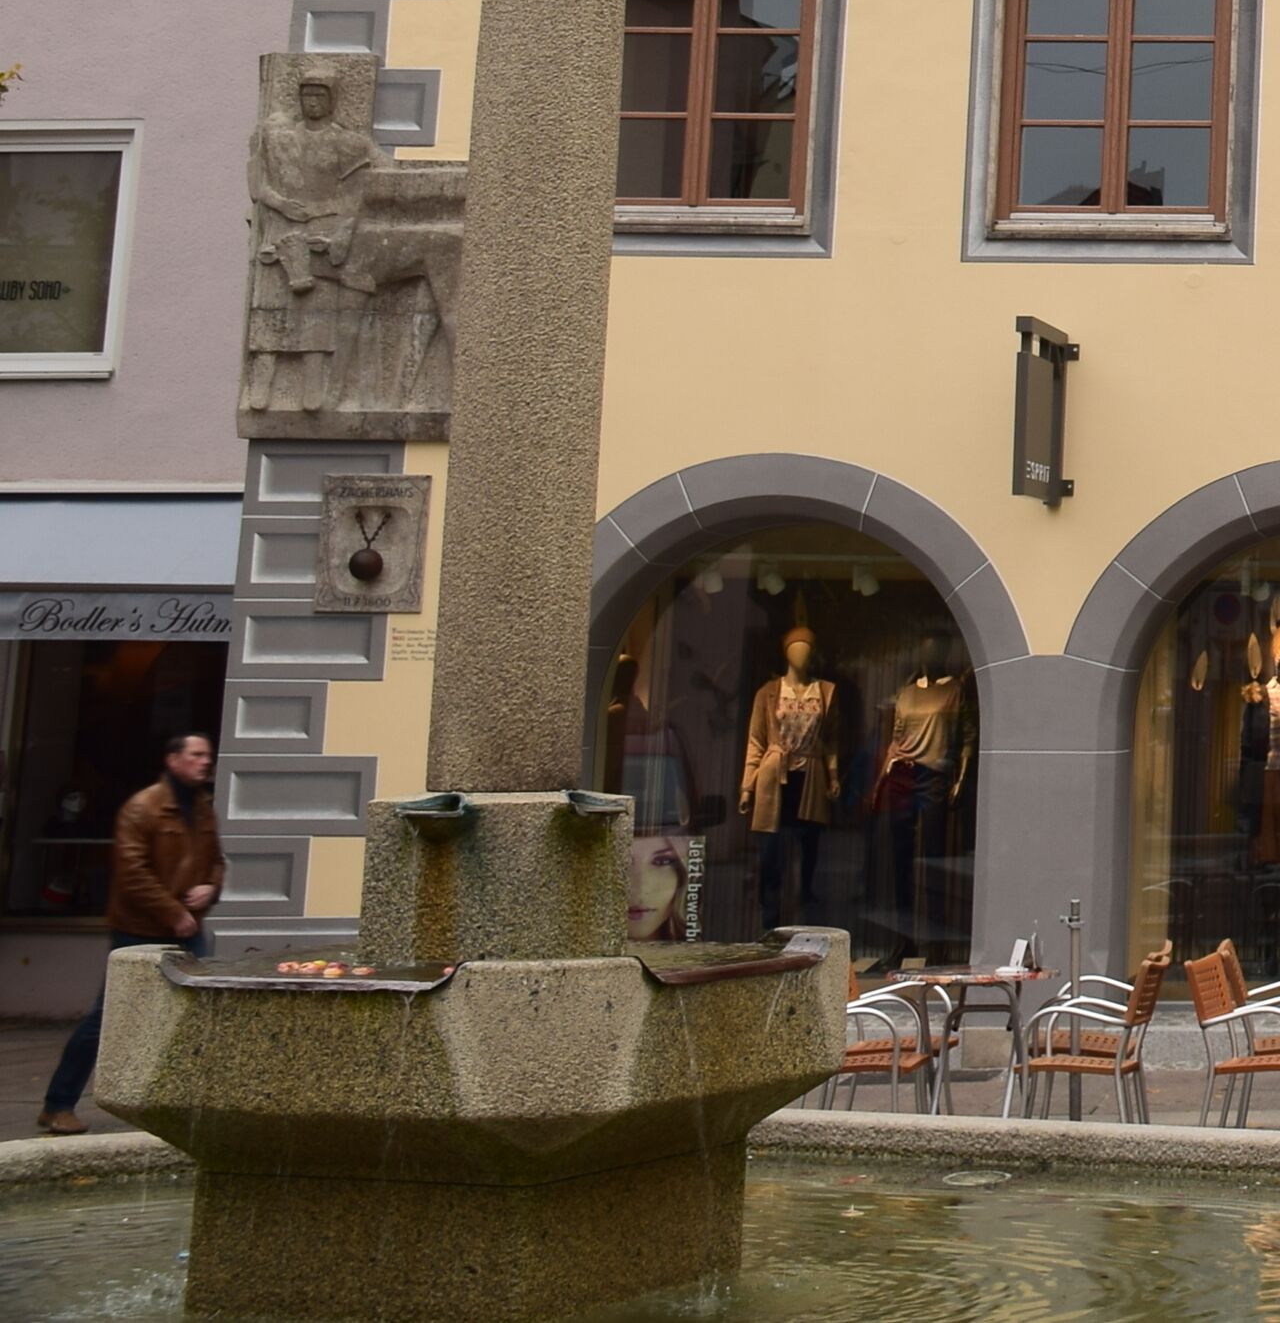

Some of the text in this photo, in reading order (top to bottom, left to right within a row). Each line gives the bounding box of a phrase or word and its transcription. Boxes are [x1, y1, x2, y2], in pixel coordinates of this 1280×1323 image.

[29, 280, 62, 301] SOHO
[1025, 460, 1051, 483] ESPRIT
[688, 840, 704, 879] Jetzt
